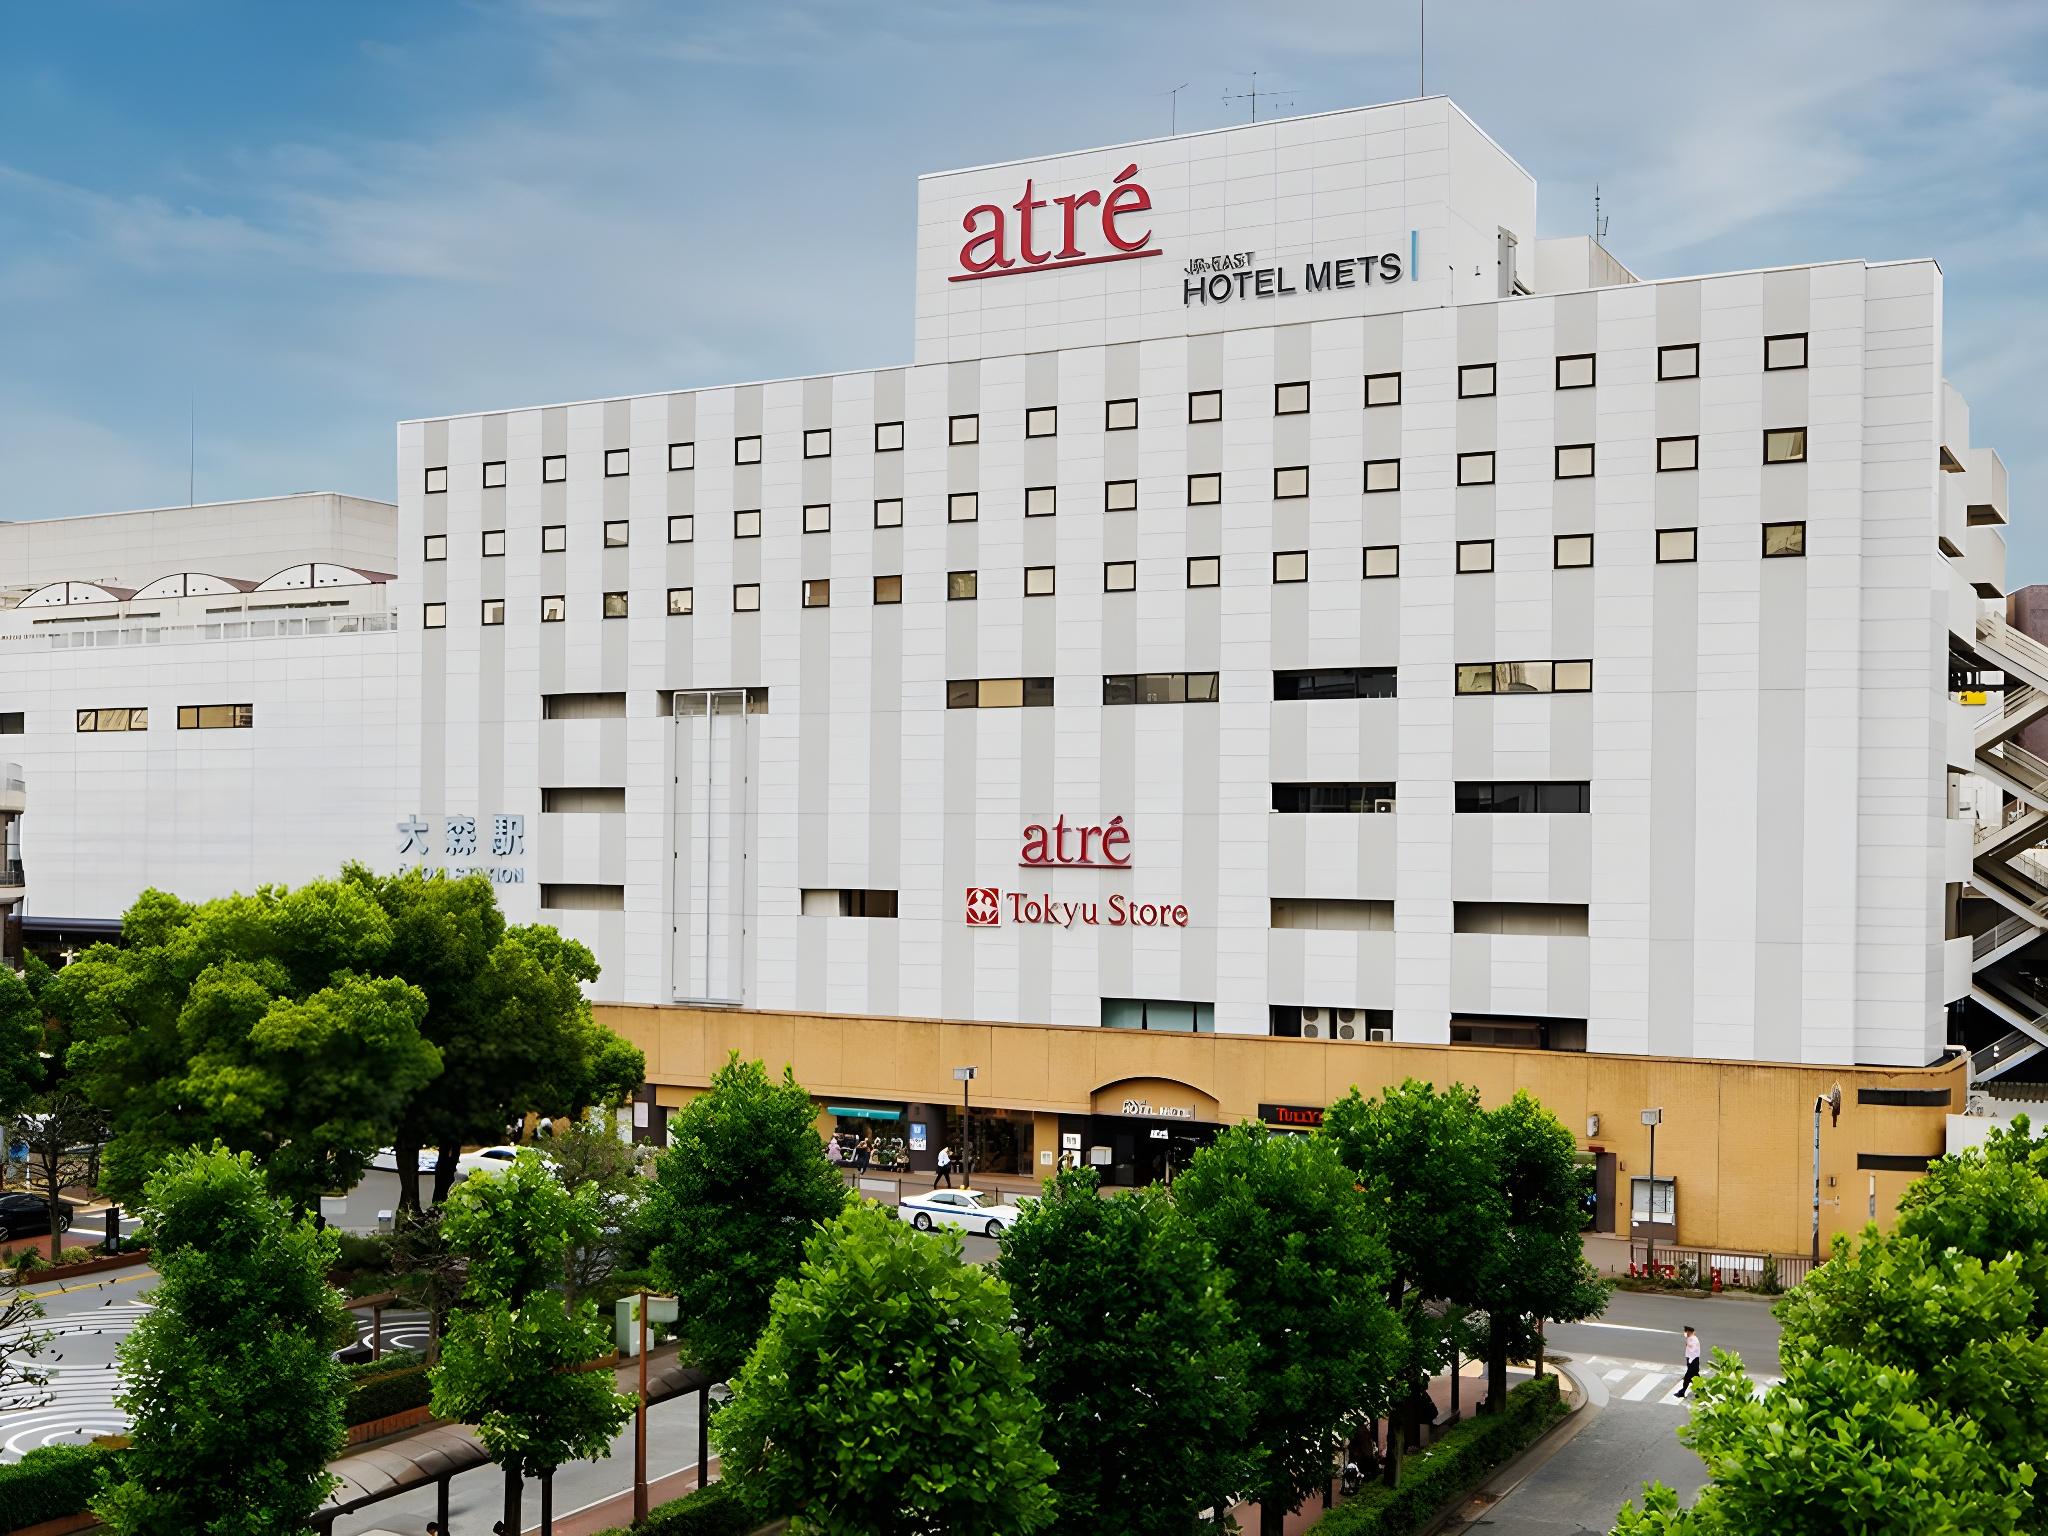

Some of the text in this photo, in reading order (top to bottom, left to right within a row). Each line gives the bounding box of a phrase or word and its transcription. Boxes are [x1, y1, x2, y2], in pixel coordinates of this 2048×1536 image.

[959, 163, 1153, 272] atré
[1184, 252, 1404, 307] HOTEL METS
[398, 813, 524, 857] 大森駅
[1021, 813, 1133, 865] atré
[1006, 892, 1190, 929] Tokyu Store
